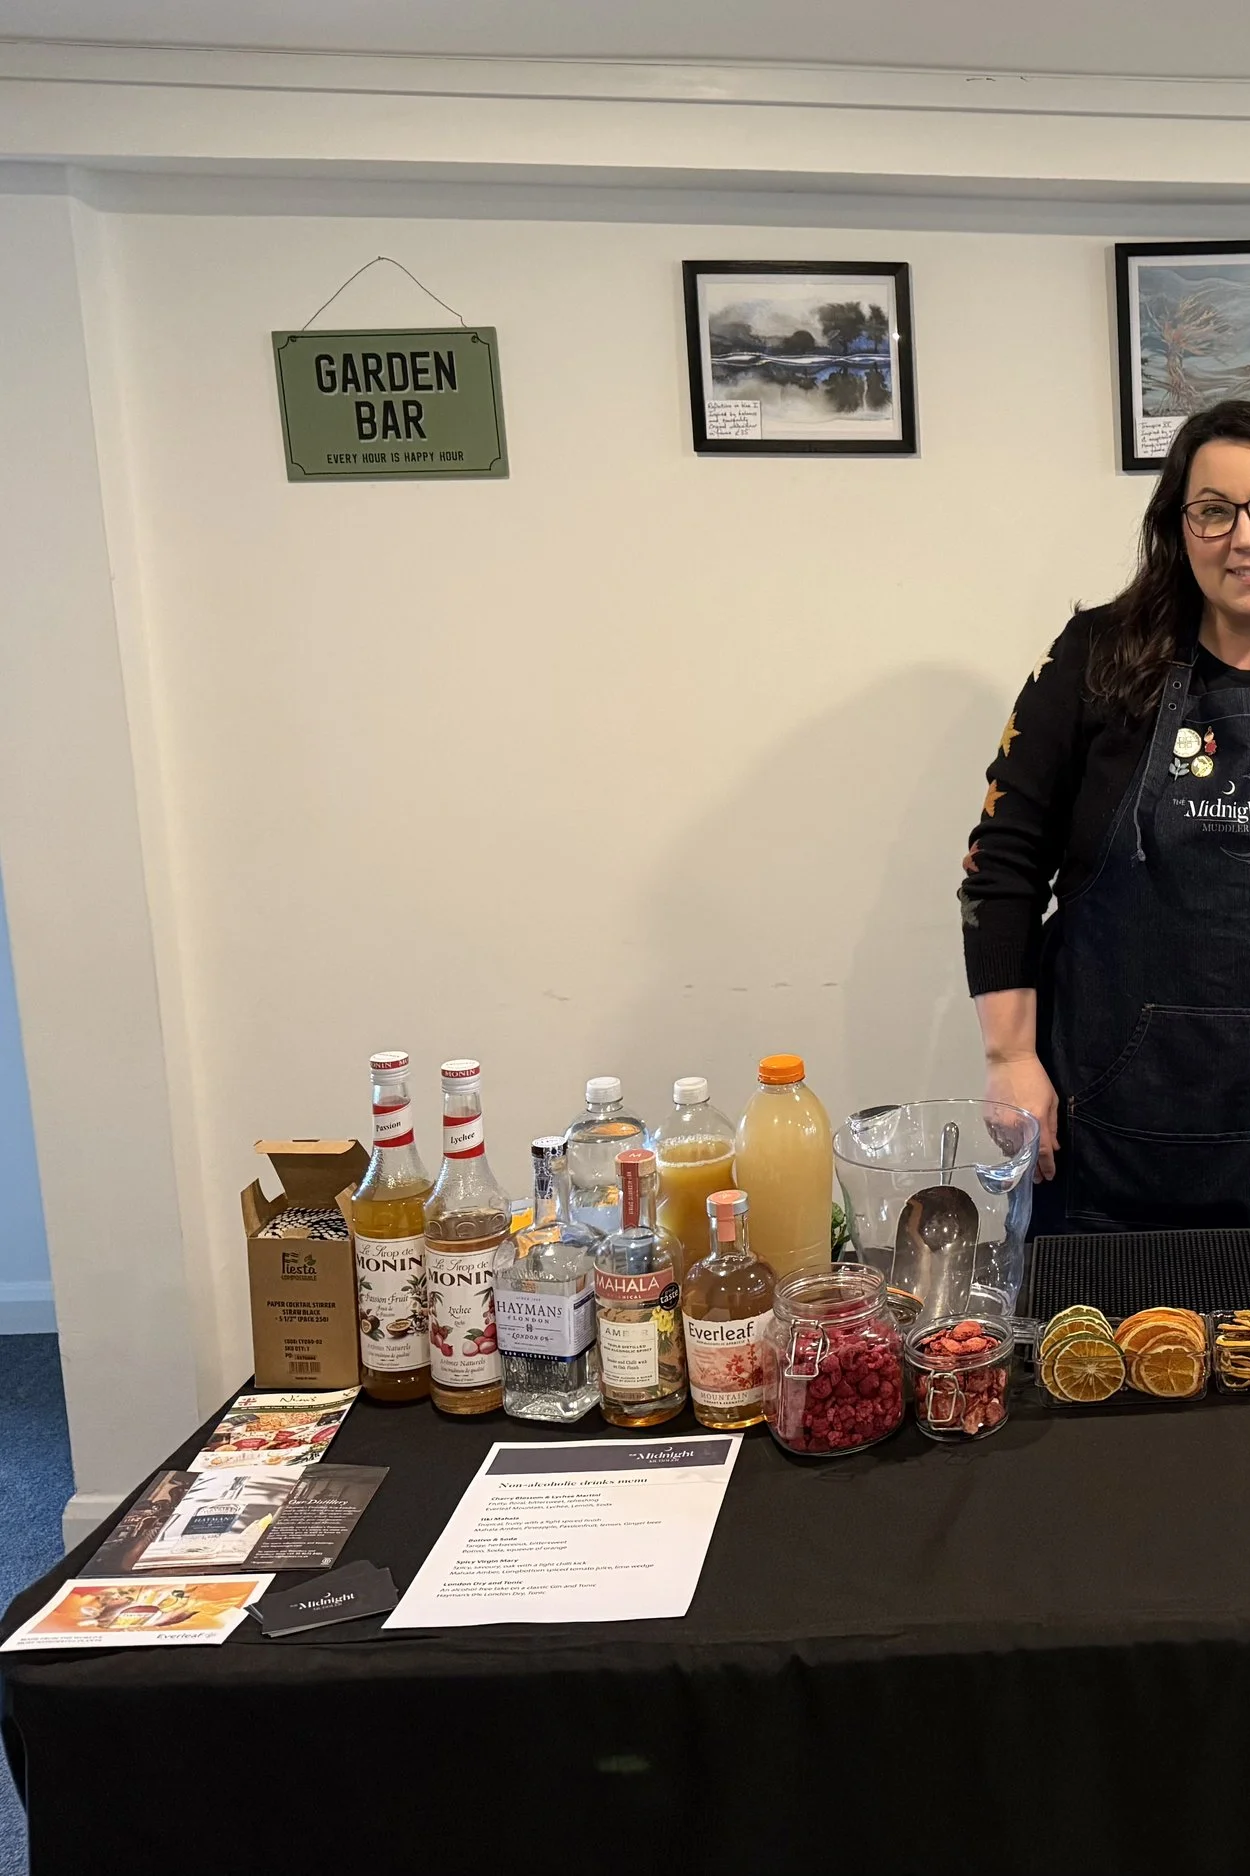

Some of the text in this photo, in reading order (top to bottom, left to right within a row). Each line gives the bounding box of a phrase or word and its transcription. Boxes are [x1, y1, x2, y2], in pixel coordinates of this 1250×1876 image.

[315, 351, 457, 394] GARDEN
[355, 400, 427, 440] BAR
[327, 451, 464, 464] EVERY HOUR IS HAPPY HOUR
[1173, 798, 1186, 807] THE
[1202, 823, 1250, 833] MUDDLER
[444, 1069, 476, 1078] MONIN
[375, 1120, 402, 1132] Passion
[450, 1131, 476, 1144] Lychee
[360, 1244, 414, 1259] Le Sirop de
[282, 1252, 318, 1274] Fiesta
[356, 1254, 424, 1272] MONIN
[432, 1259, 489, 1273] Le Sirop de
[428, 1269, 494, 1287] MONIN
[596, 1274, 660, 1293] MAHALA
[387, 1292, 409, 1305] Fruit
[660, 1289, 679, 1304] taste
[266, 1300, 285, 1308] PAPER
[448, 1305, 472, 1319] Lychee
[513, 1316, 550, 1324] LONDON
[512, 1332, 539, 1341] LONDON
[688, 1321, 755, 1341] Everleaf
[701, 1391, 748, 1401] MOUNTAIN
[636, 1450, 694, 1461] Midnight
[498, 1480, 577, 1488] Non-alcoholic
[299, 1593, 355, 1610] Midnight
